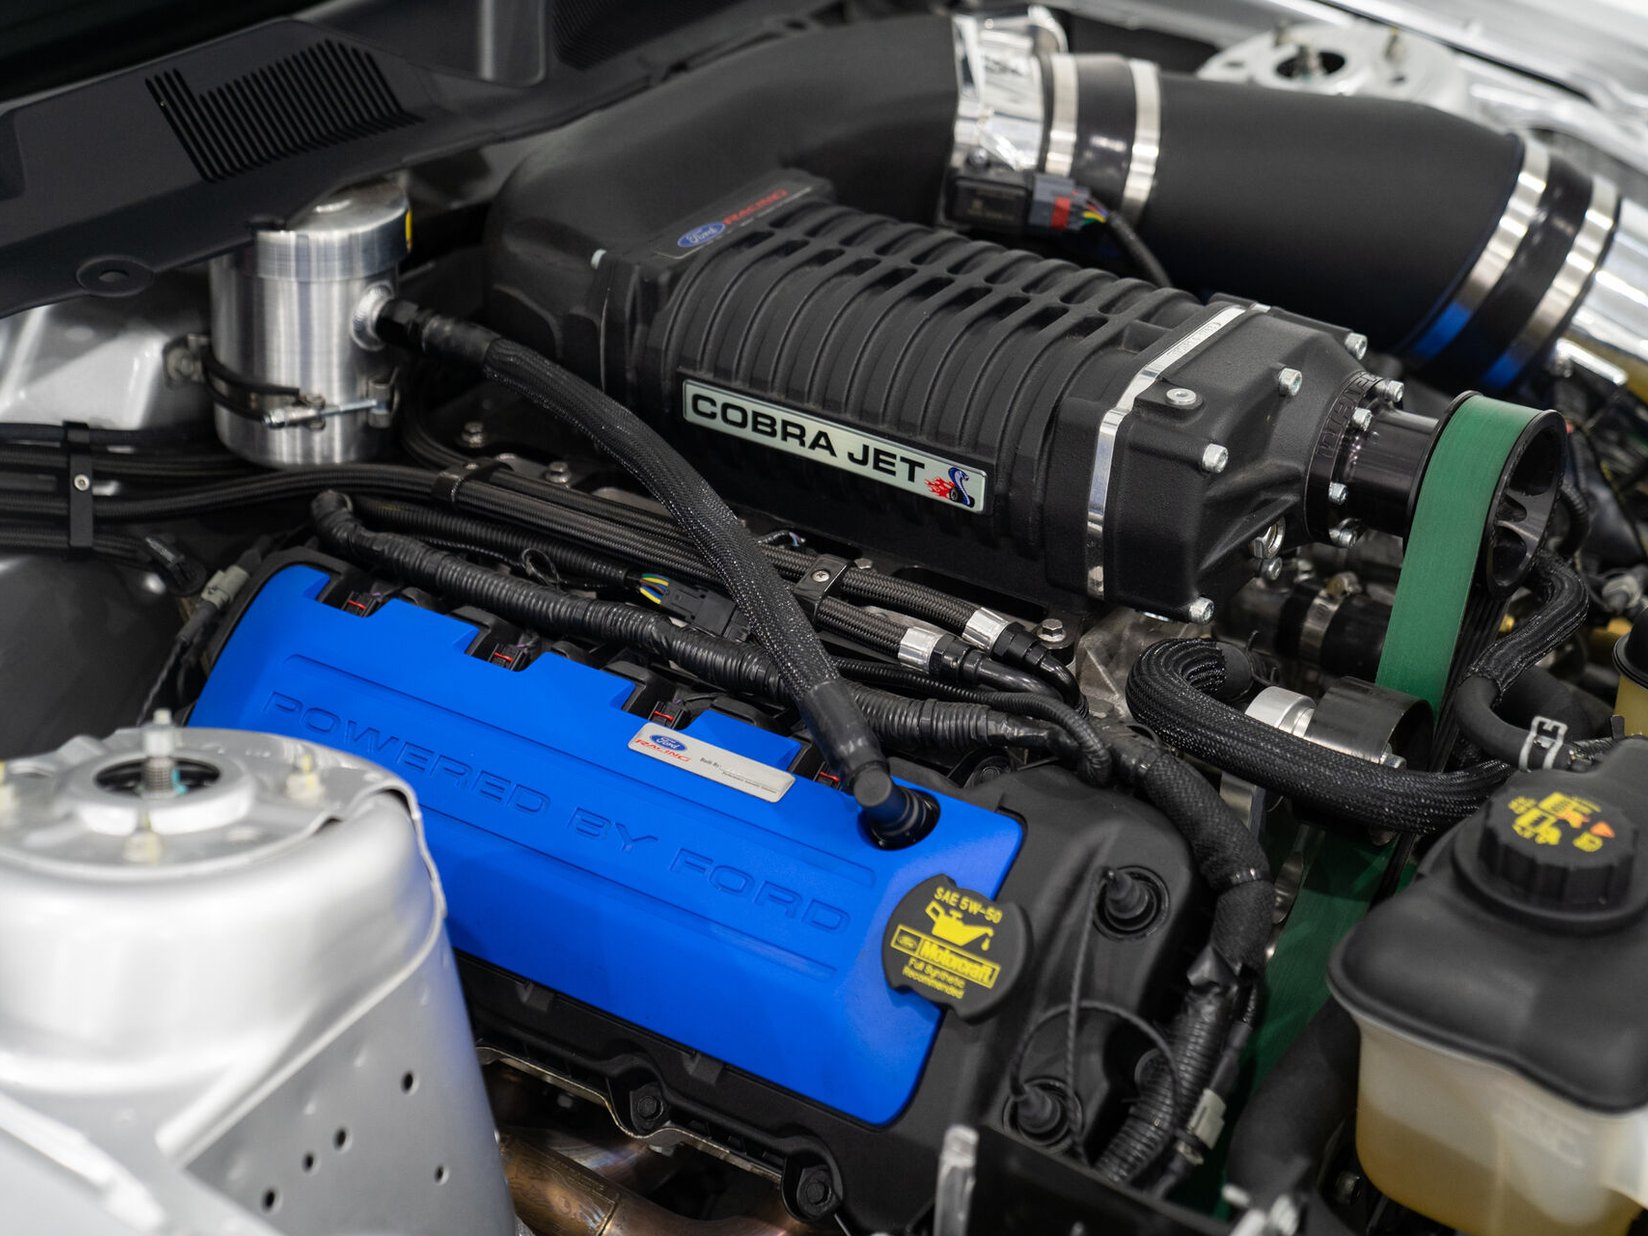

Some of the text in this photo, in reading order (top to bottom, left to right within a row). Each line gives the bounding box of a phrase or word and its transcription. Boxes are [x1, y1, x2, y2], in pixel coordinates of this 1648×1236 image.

[683, 225, 720, 245] Ford
[691, 393, 926, 482] COBRA JET
[635, 738, 691, 762] RACING
[654, 736, 682, 749] Ford
[262, 691, 849, 932] POWERED BY FORD
[934, 886, 1003, 924] SAE 5W-50
[908, 956, 925, 971] Full
[919, 940, 993, 983] Motorcraft
